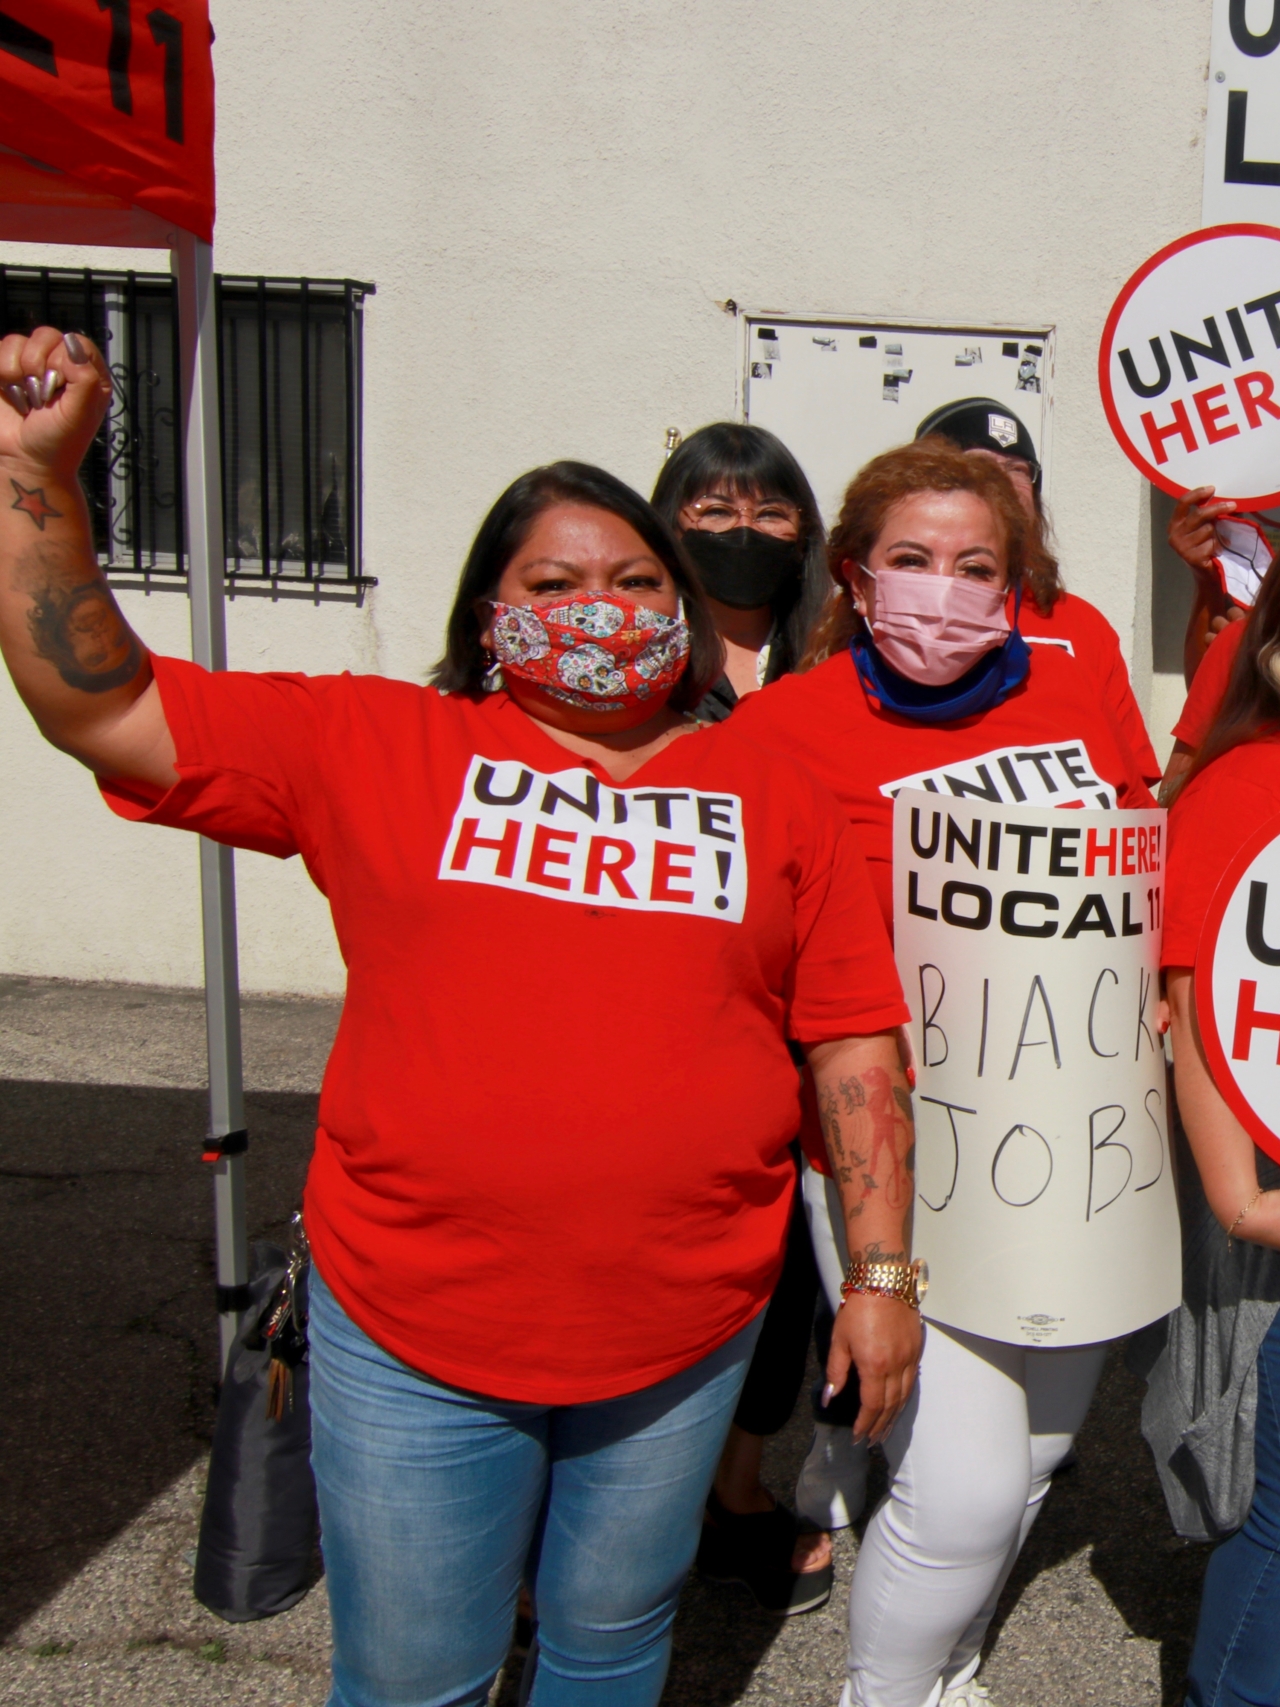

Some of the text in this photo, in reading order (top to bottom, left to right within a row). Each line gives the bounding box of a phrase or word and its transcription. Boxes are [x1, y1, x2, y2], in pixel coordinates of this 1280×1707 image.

[992, 417, 1015, 431] LA
[473, 762, 737, 843] UNITE
[890, 747, 1100, 804] NITE
[449, 817, 732, 910] HERE!
[910, 806, 1161, 877] UNITEHERE!
[907, 870, 1160, 938] LOCAL 11
[918, 1088, 1165, 1222] JOBS
